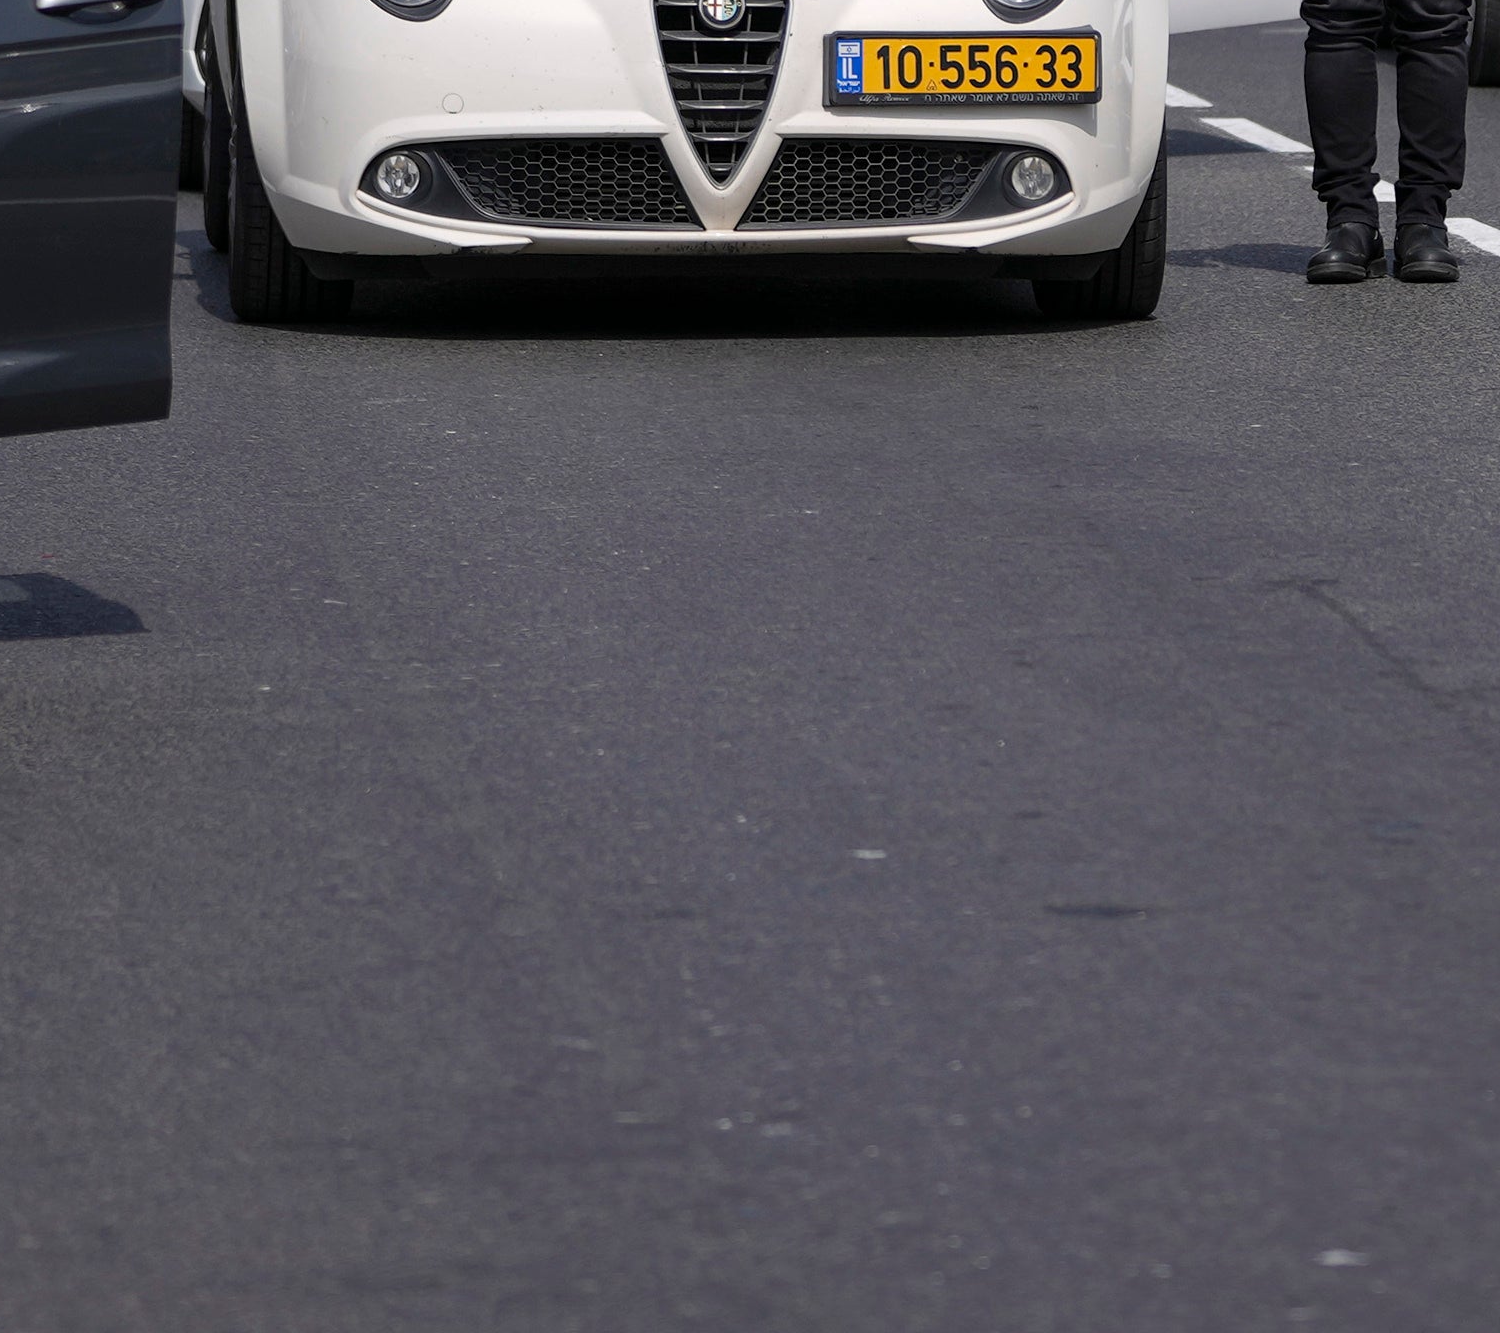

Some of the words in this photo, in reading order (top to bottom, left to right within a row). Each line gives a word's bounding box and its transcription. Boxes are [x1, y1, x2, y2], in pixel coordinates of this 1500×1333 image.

[842, 57, 858, 79] IL
[936, 93, 967, 102] שאתה
[971, 93, 994, 103] אומר
[997, 92, 1009, 102] לא
[1011, 93, 1034, 102] נושם
[1036, 93, 1065, 102] שאתה
[1068, 93, 1080, 102] זה
